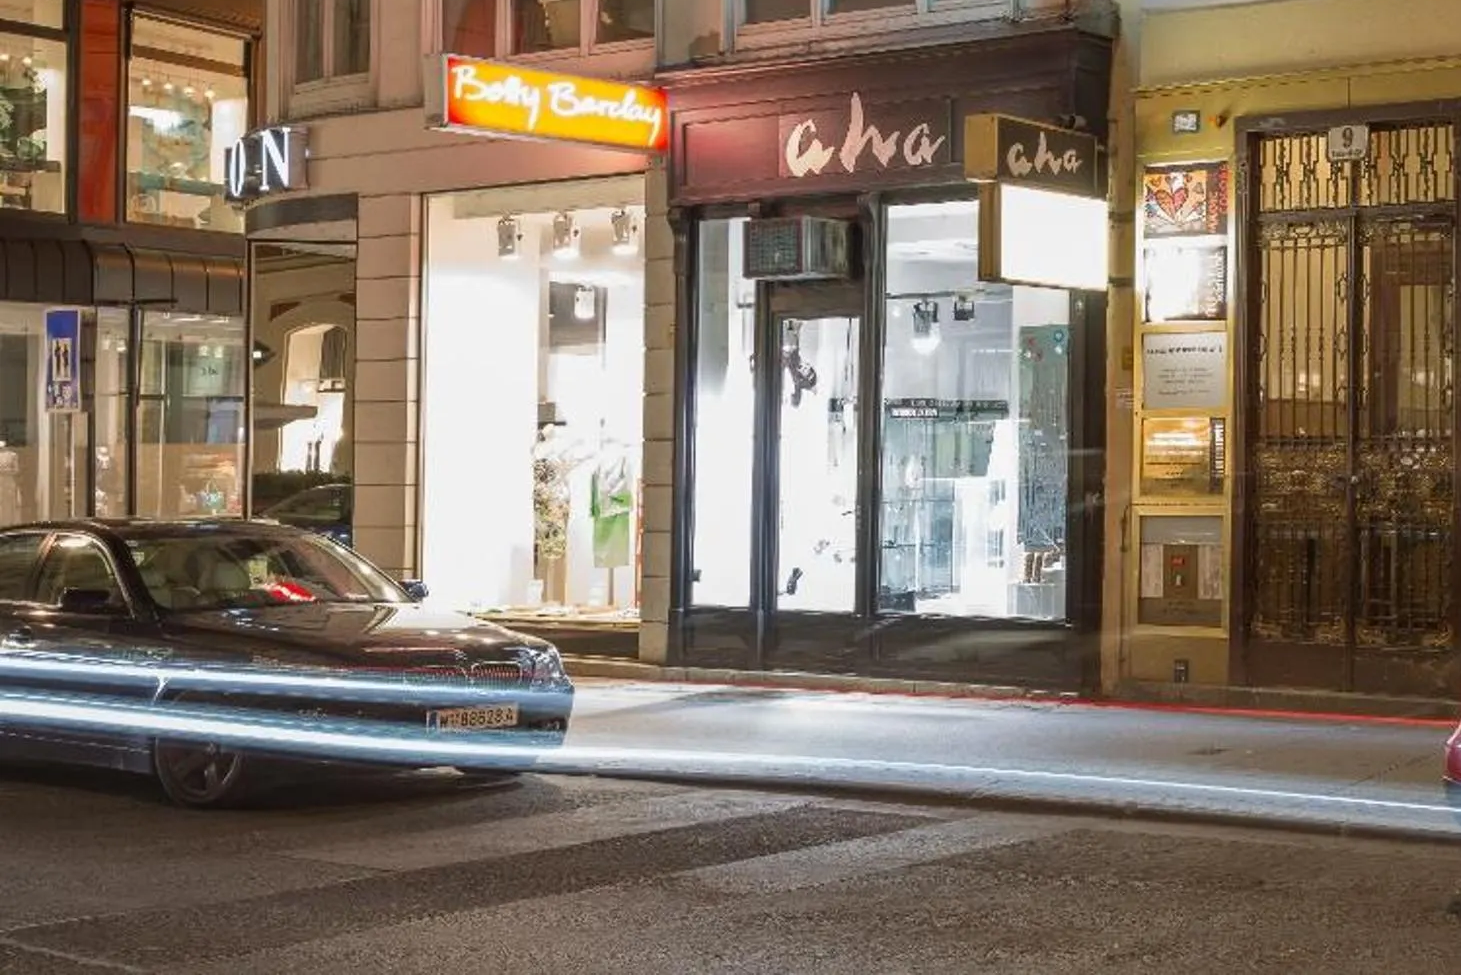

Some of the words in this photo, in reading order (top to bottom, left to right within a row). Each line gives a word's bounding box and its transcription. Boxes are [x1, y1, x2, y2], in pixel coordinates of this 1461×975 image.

[547, 81, 662, 146] Barclay
[785, 91, 945, 177] aha
[1342, 127, 1354, 149] 9
[1006, 131, 1083, 176] aha
